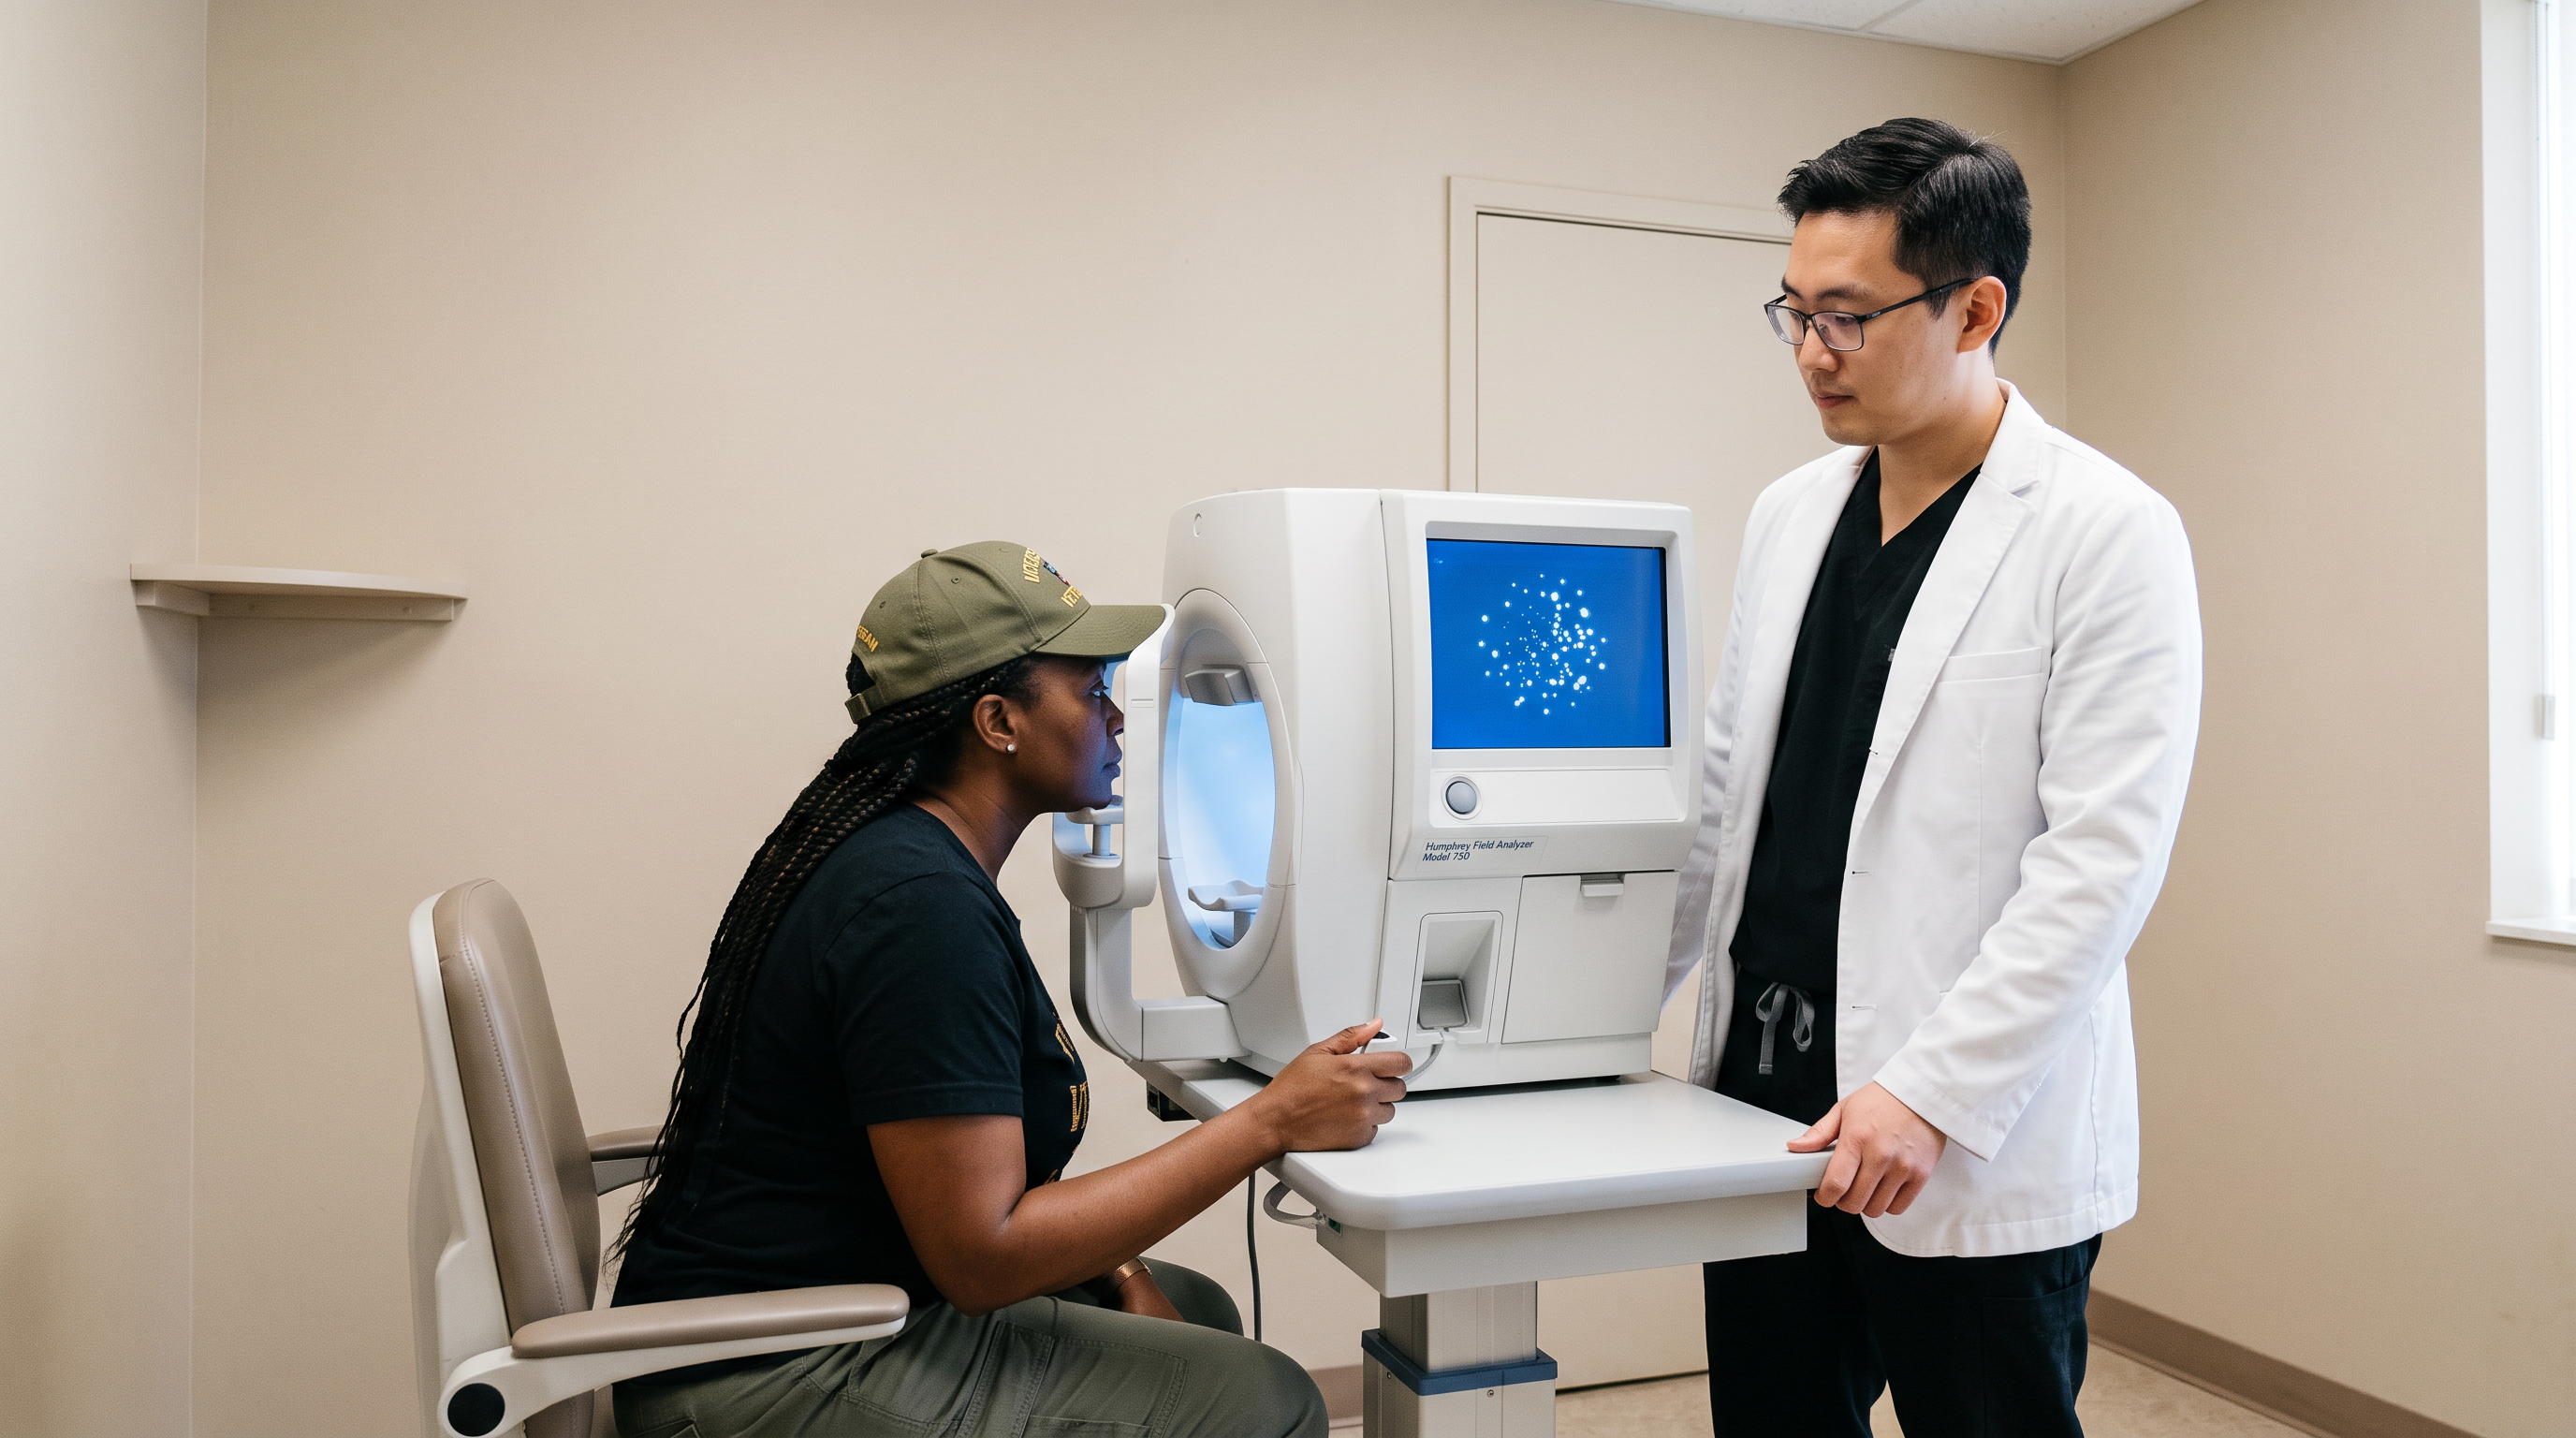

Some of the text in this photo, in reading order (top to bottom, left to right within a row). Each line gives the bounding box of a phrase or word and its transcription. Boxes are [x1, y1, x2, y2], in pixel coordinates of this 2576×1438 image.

[1426, 840, 1534, 852] Humphrey Field Analyzer
[1422, 852, 1471, 861] Model 750
